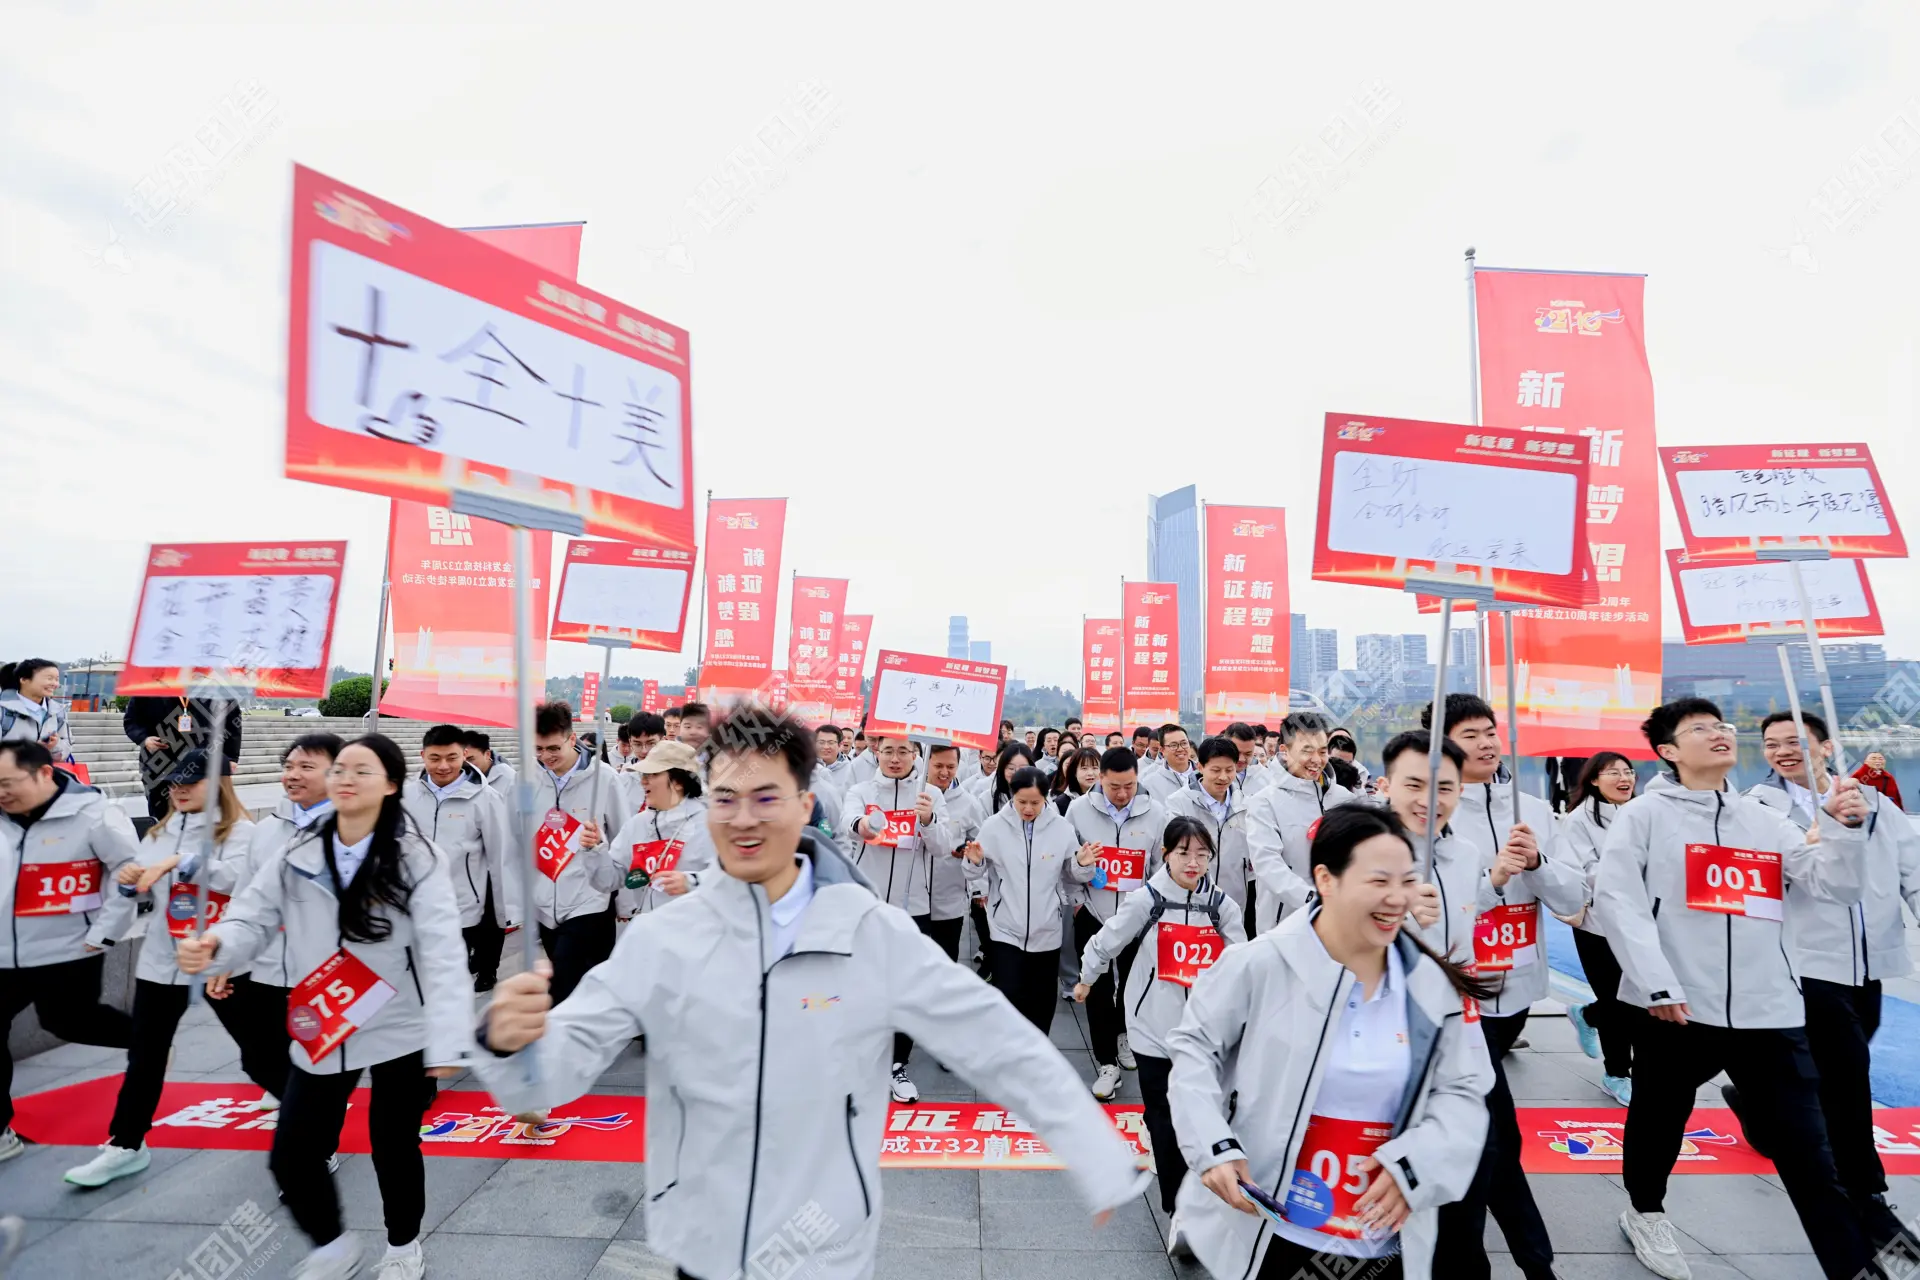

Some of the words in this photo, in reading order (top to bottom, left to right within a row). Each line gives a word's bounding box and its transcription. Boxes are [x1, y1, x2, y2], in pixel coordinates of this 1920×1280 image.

[329, 284, 675, 489] 十全十美
[1223, 553, 1246, 626] 新征程
[1250, 580, 1274, 653] 新梦想
[884, 821, 911, 834] 50
[539, 828, 570, 861] 072
[1099, 859, 1133, 876] 003
[1706, 863, 1768, 893] 001
[38, 874, 92, 897] 105
[1173, 941, 1214, 964] 022
